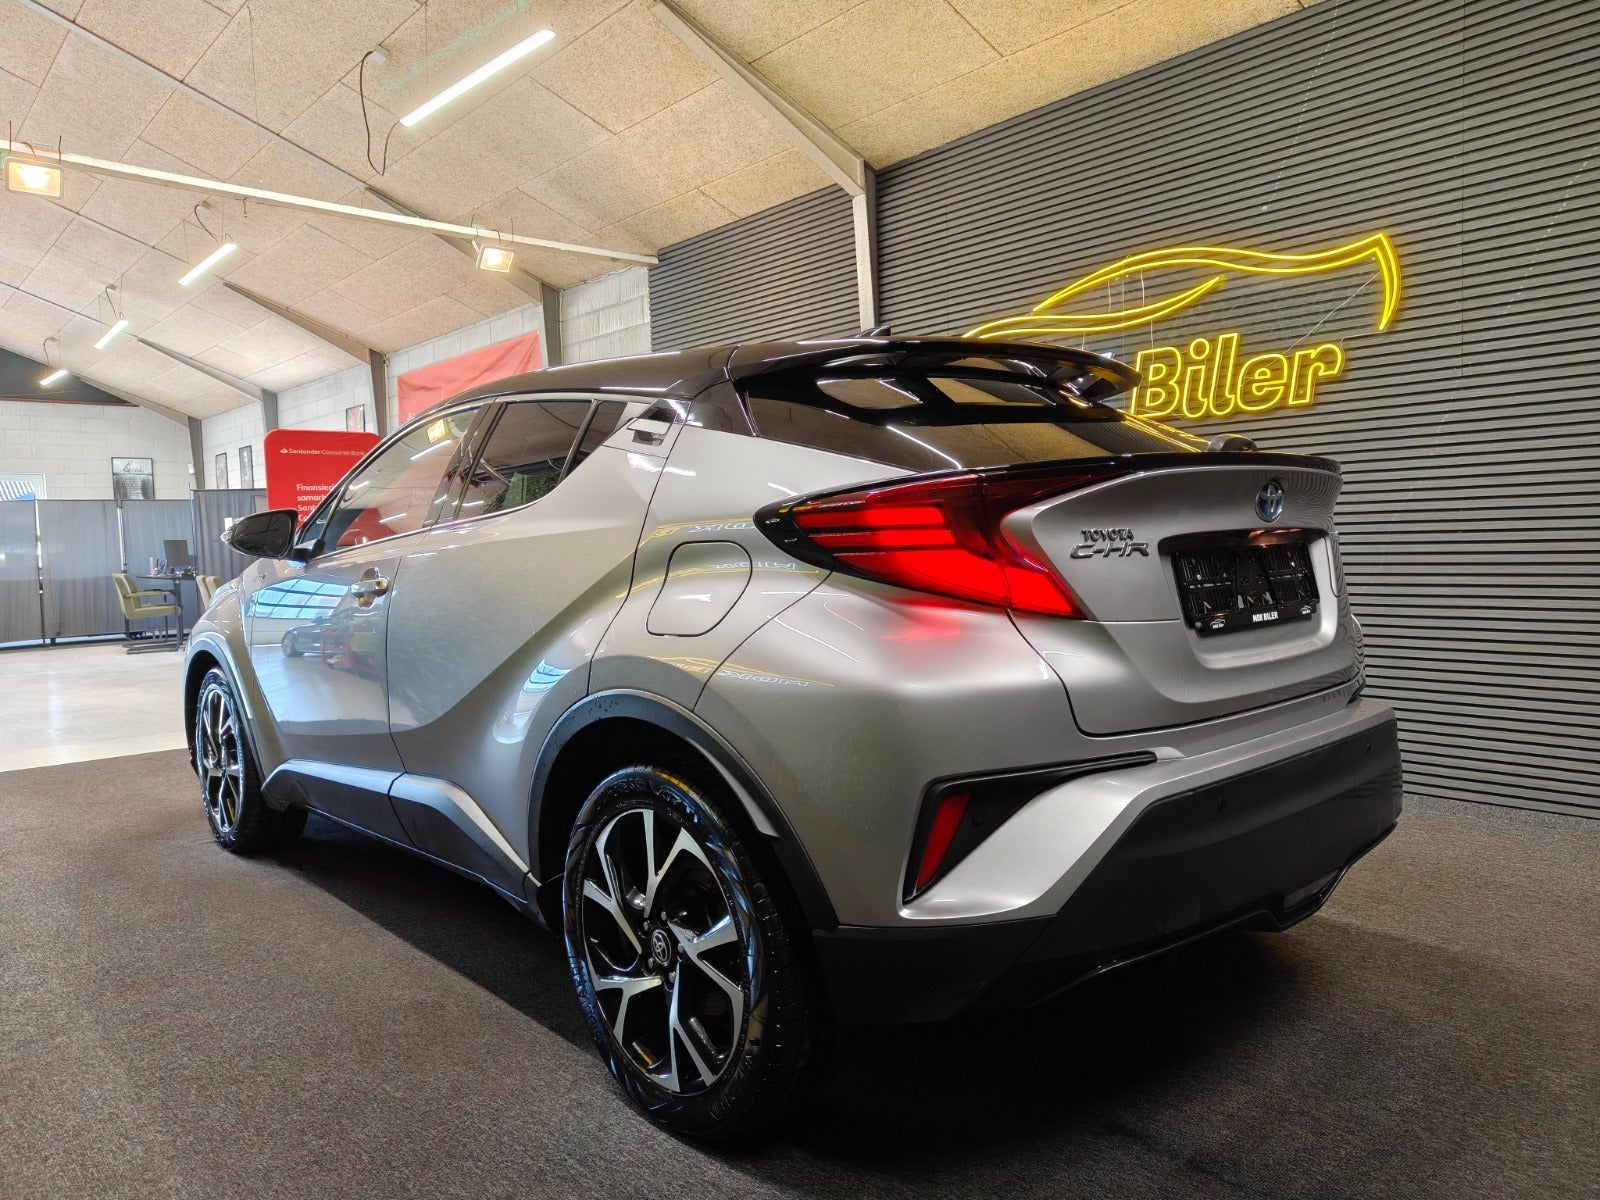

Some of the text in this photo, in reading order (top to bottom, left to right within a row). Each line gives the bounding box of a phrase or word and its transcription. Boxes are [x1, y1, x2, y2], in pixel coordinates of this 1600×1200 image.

[1131, 332, 1344, 419] Biler
[1081, 528, 1134, 542] TOYOTA
[1070, 542, 1150, 559] C-HR
